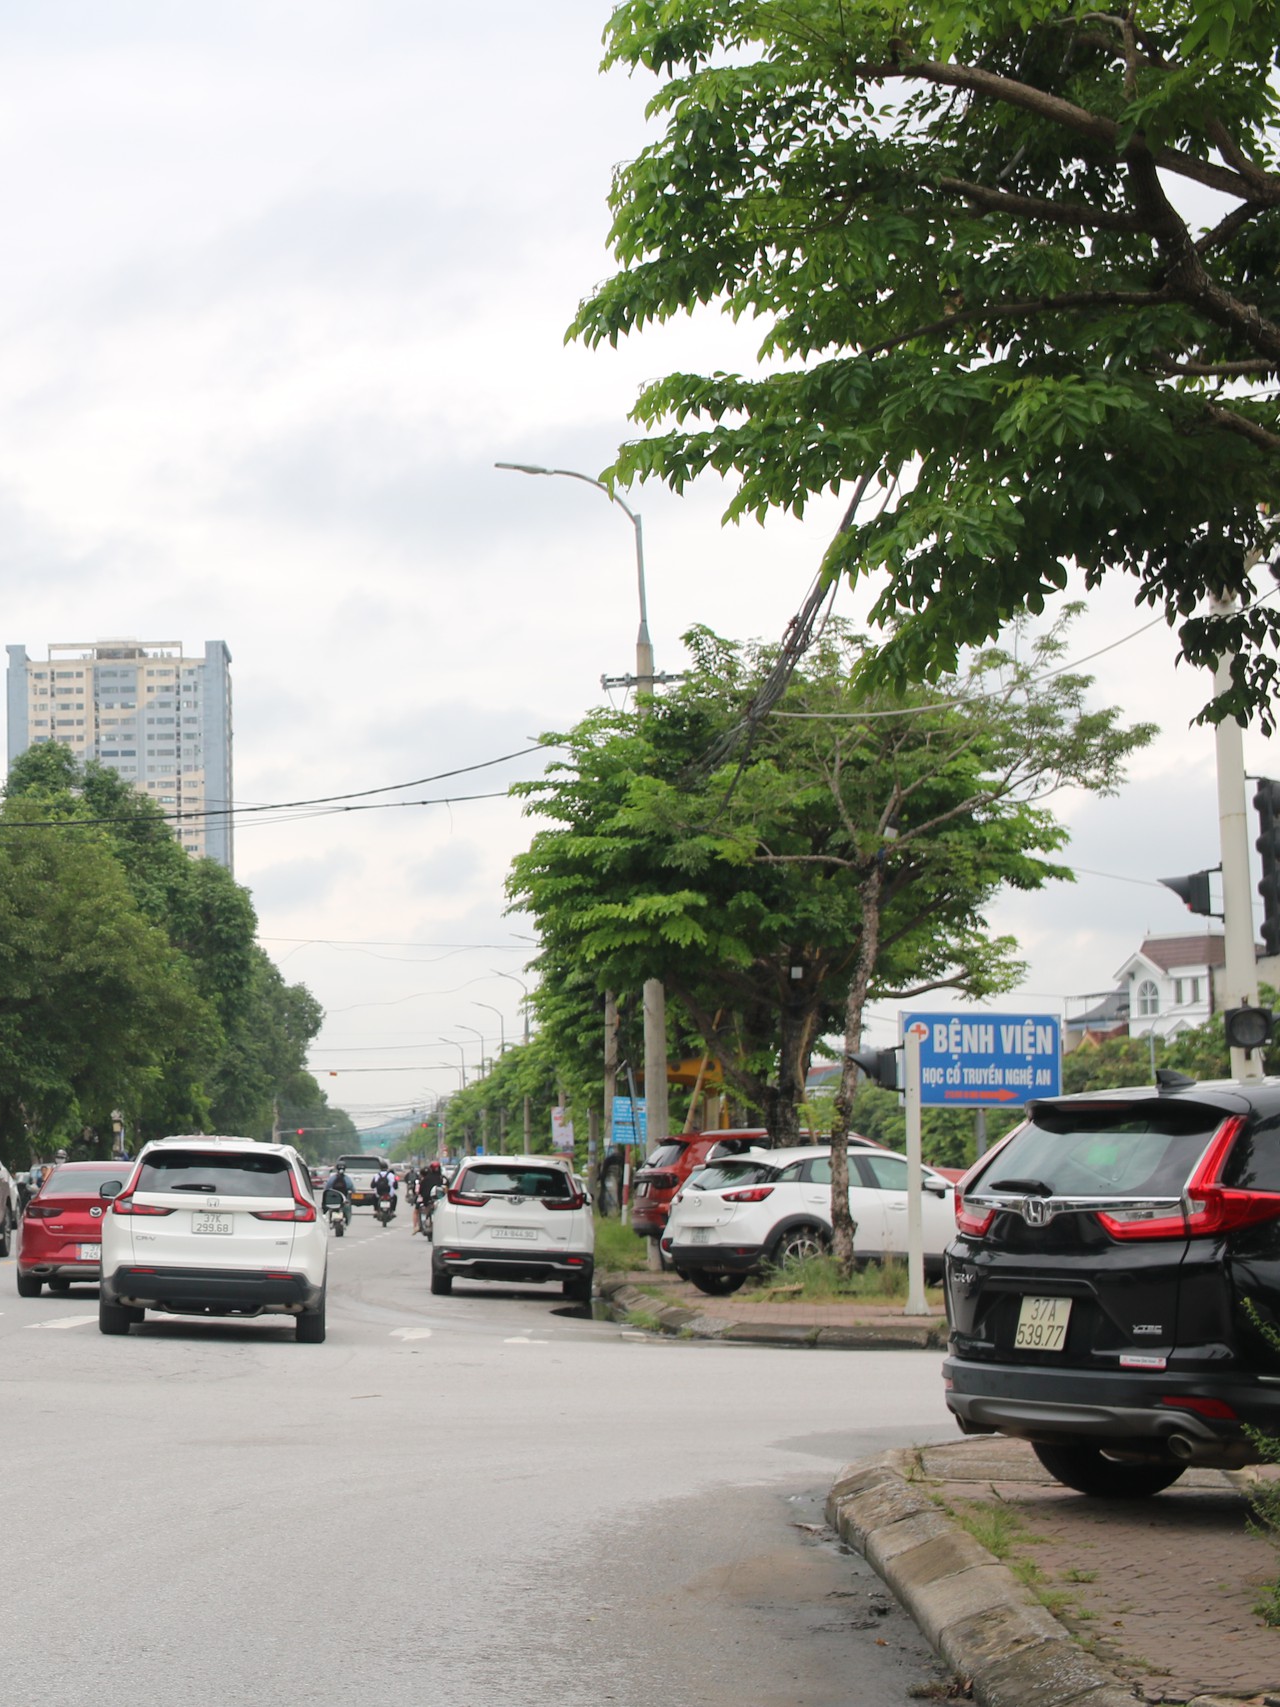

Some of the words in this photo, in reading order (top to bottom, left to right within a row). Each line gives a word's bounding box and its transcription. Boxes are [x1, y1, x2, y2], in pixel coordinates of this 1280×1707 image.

[933, 1018, 994, 1060] BỆNH
[1000, 1019, 1053, 1061] VIỆN
[922, 1067, 944, 1087] HỌC
[1005, 1065, 1033, 1089] NGHỆ
[1035, 1069, 1051, 1086] AN
[196, 1223, 229, 1233] 299.68
[204, 1214, 221, 1223] 37K
[1031, 1299, 1056, 1321] 37A
[1017, 1323, 1064, 1347] 539.77
